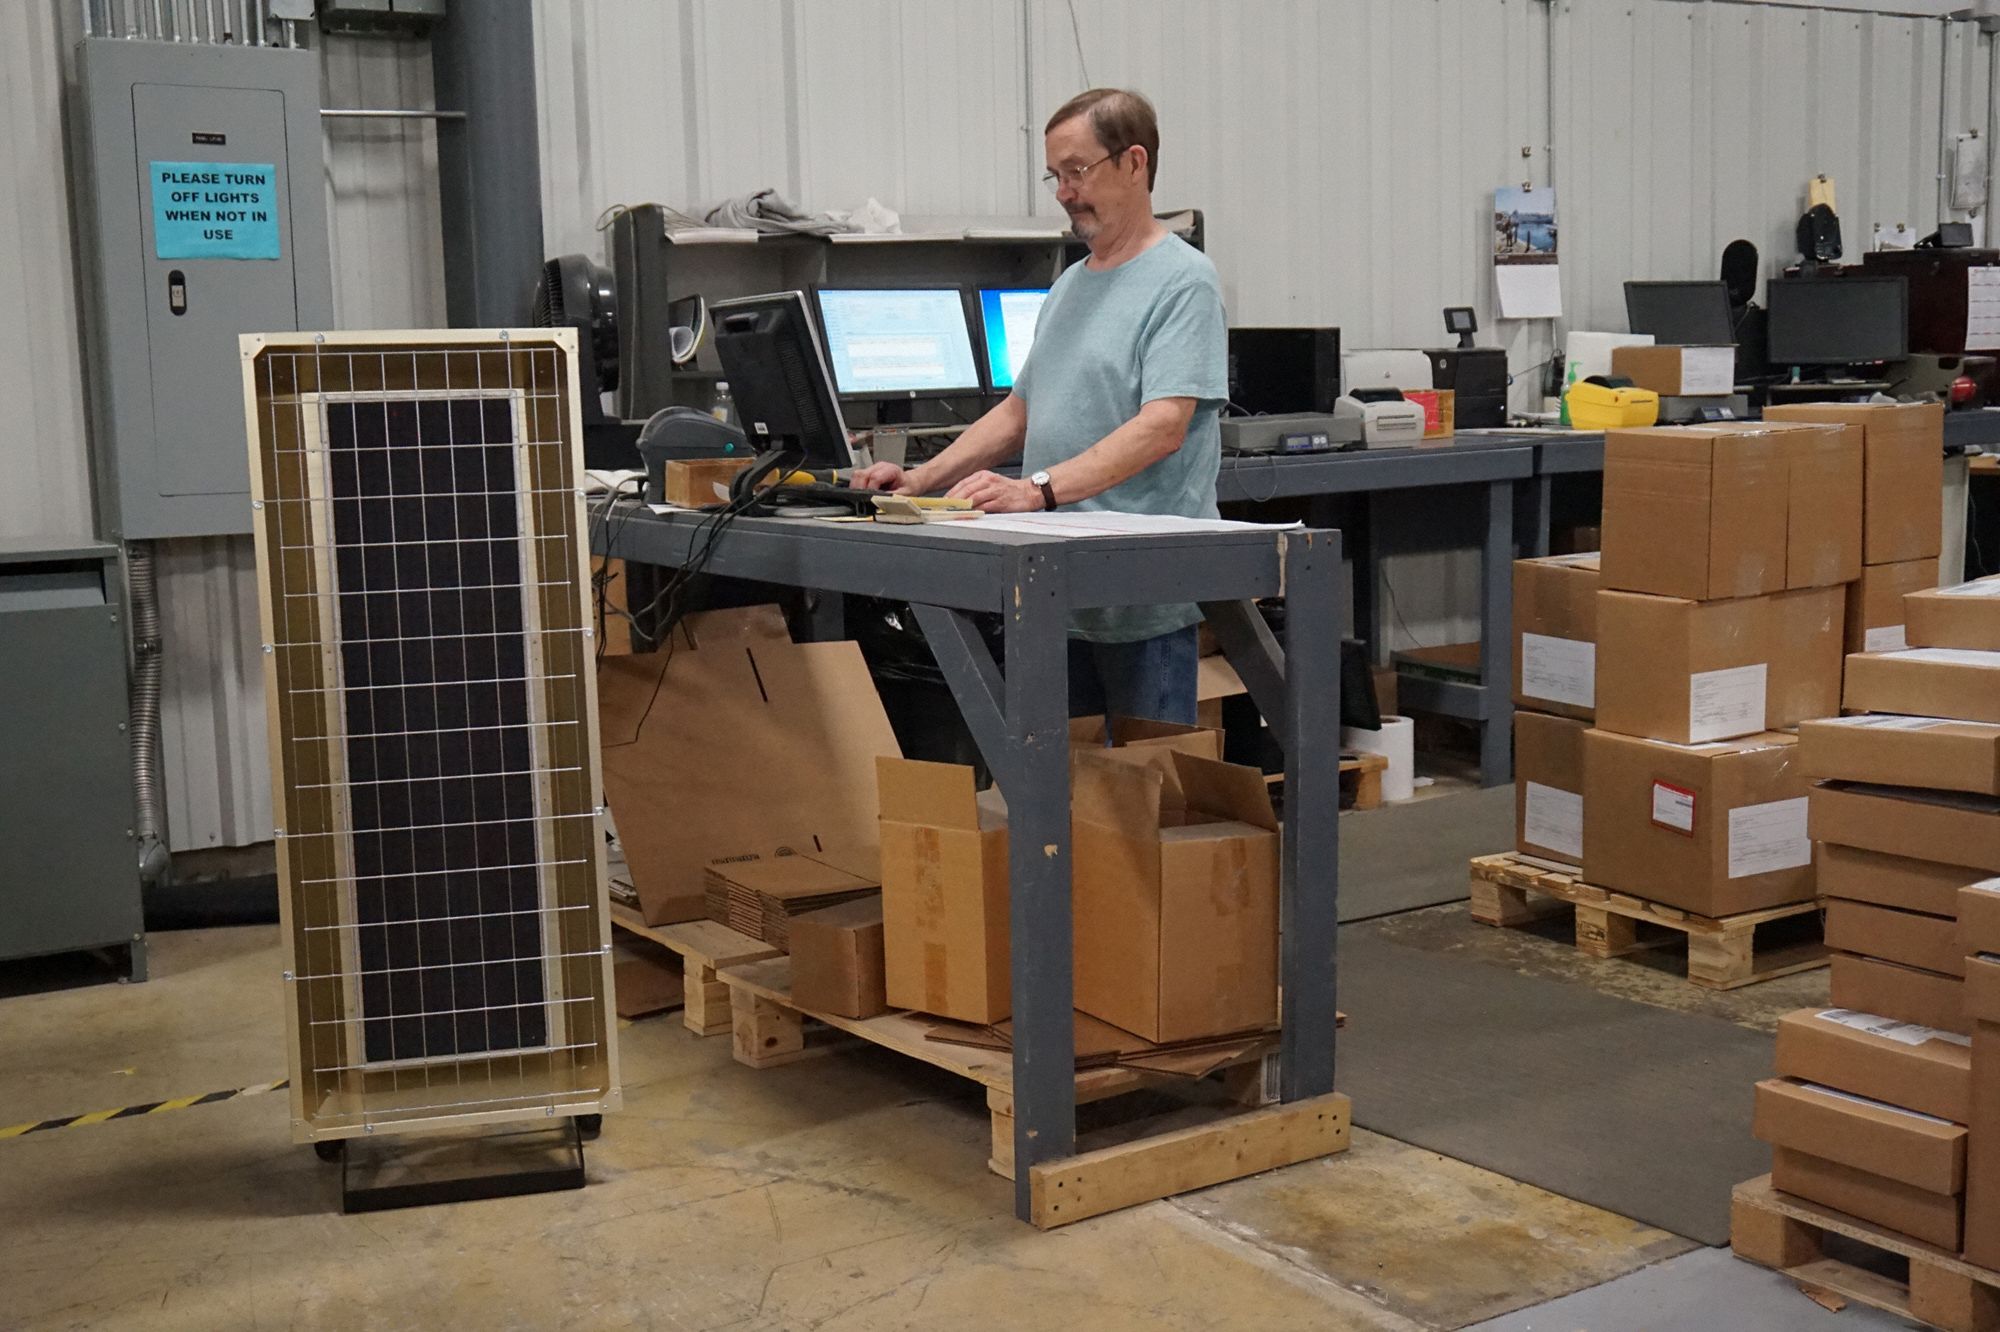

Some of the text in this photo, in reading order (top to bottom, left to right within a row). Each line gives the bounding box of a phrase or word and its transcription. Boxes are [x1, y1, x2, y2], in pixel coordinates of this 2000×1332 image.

[162, 172, 266, 185] PLEASE TURN
[171, 191, 260, 203] OFF LIGHTS
[165, 210, 267, 222] WHEN NOT IN
[204, 229, 233, 240] USE
